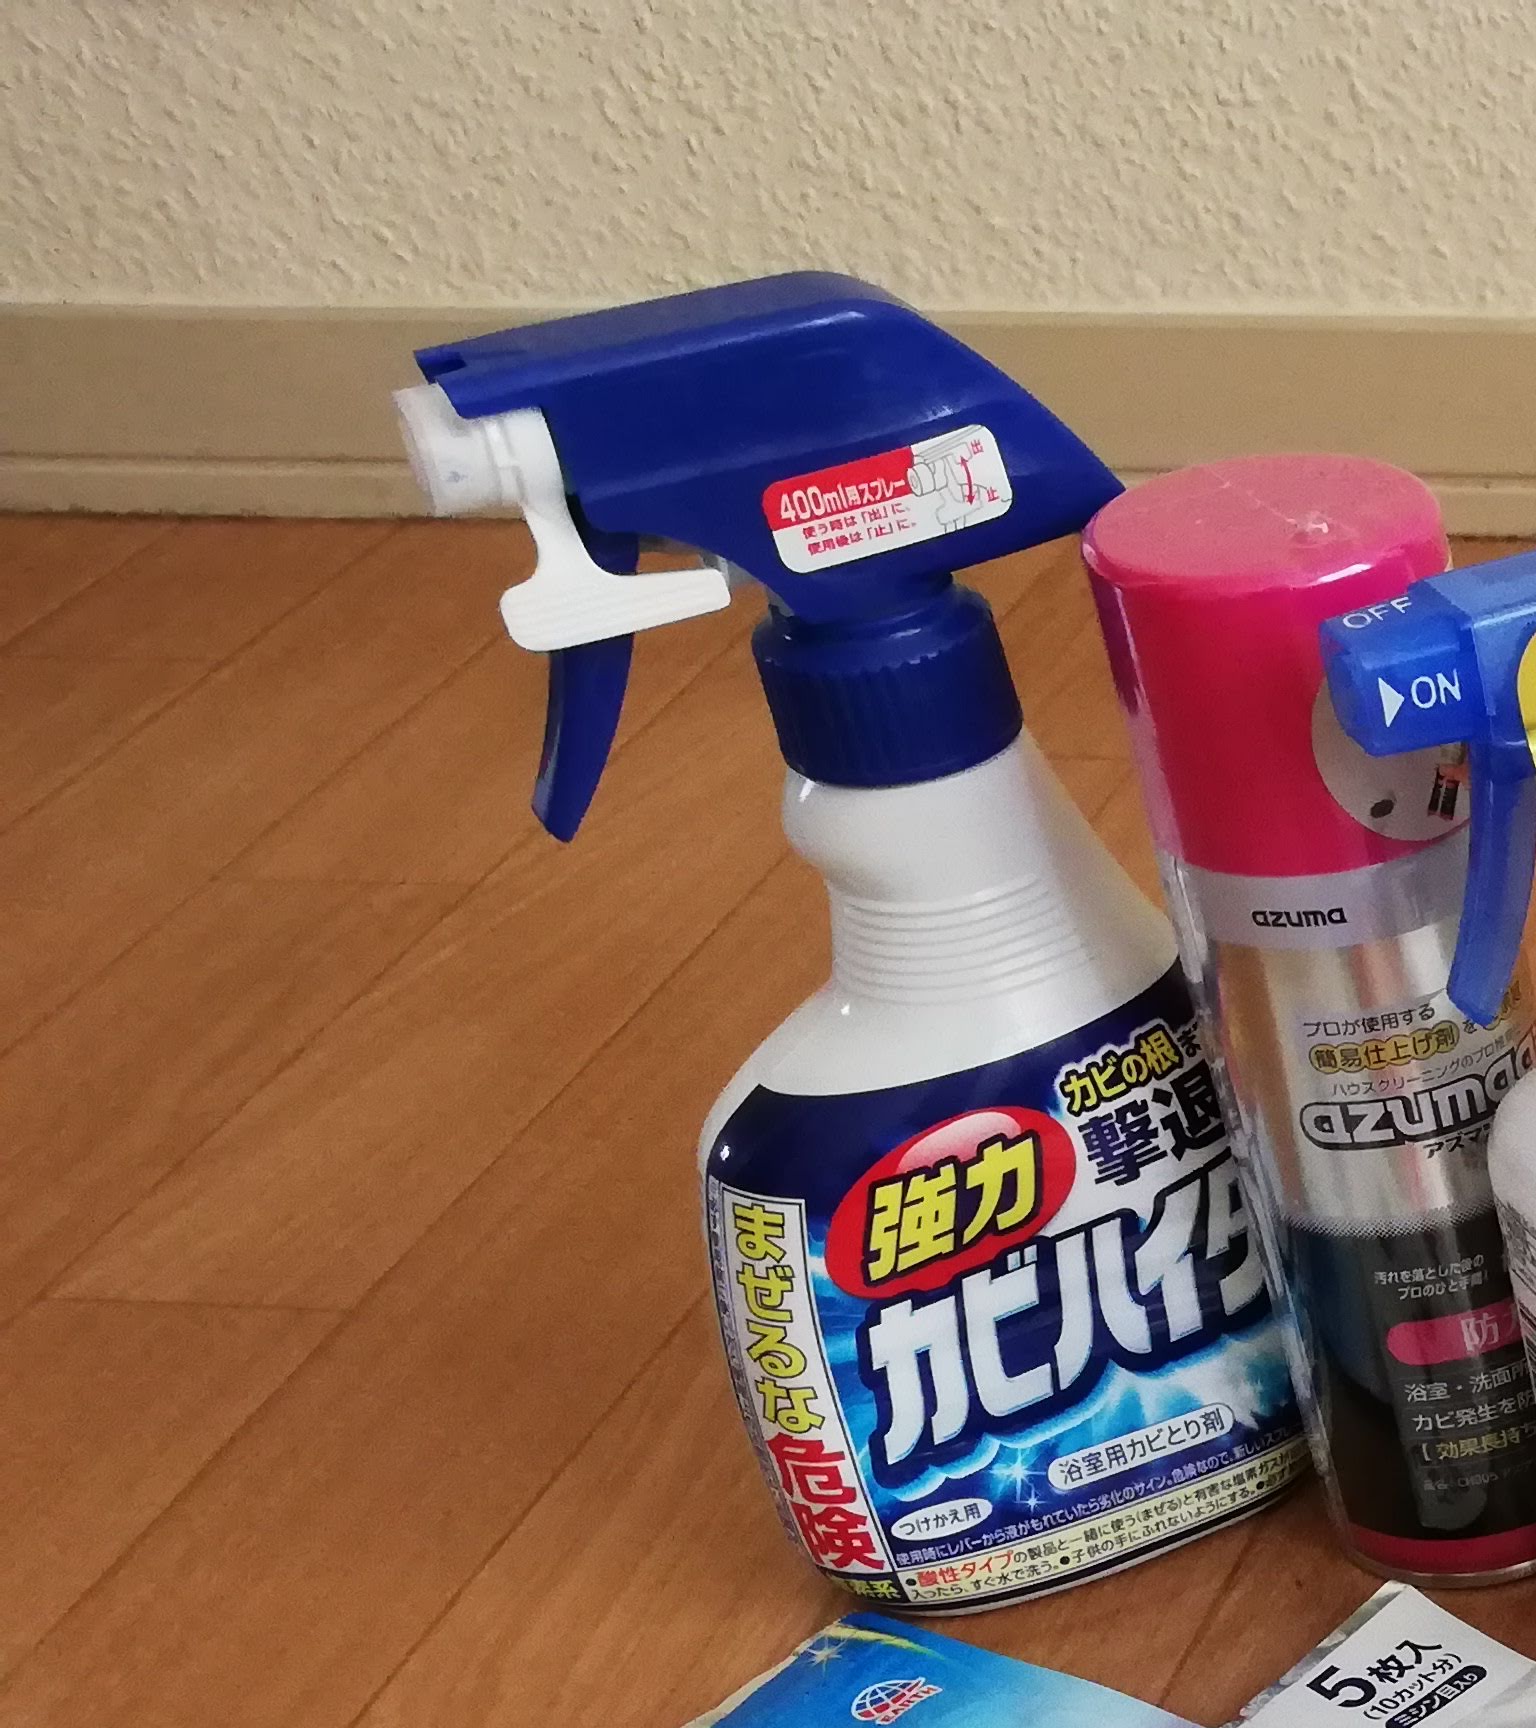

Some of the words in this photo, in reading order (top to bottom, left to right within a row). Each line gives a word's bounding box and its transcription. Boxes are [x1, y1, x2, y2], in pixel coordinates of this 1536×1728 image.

[1342, 597, 1412, 632] OFF
[1410, 669, 1462, 709] ON
[1251, 906, 1348, 929] azuma
[1303, 1003, 1436, 1038] プロが使用する
[866, 1138, 1041, 1284] 強力
[731, 1201, 887, 1572] まぜるな危険
[1059, 1407, 1226, 1486] 浴室用カビとり剤
[899, 1502, 982, 1536] つけかえ用
[1306, 1640, 1443, 1708] 5枚入
[1363, 1653, 1463, 1720] (10カット分)
